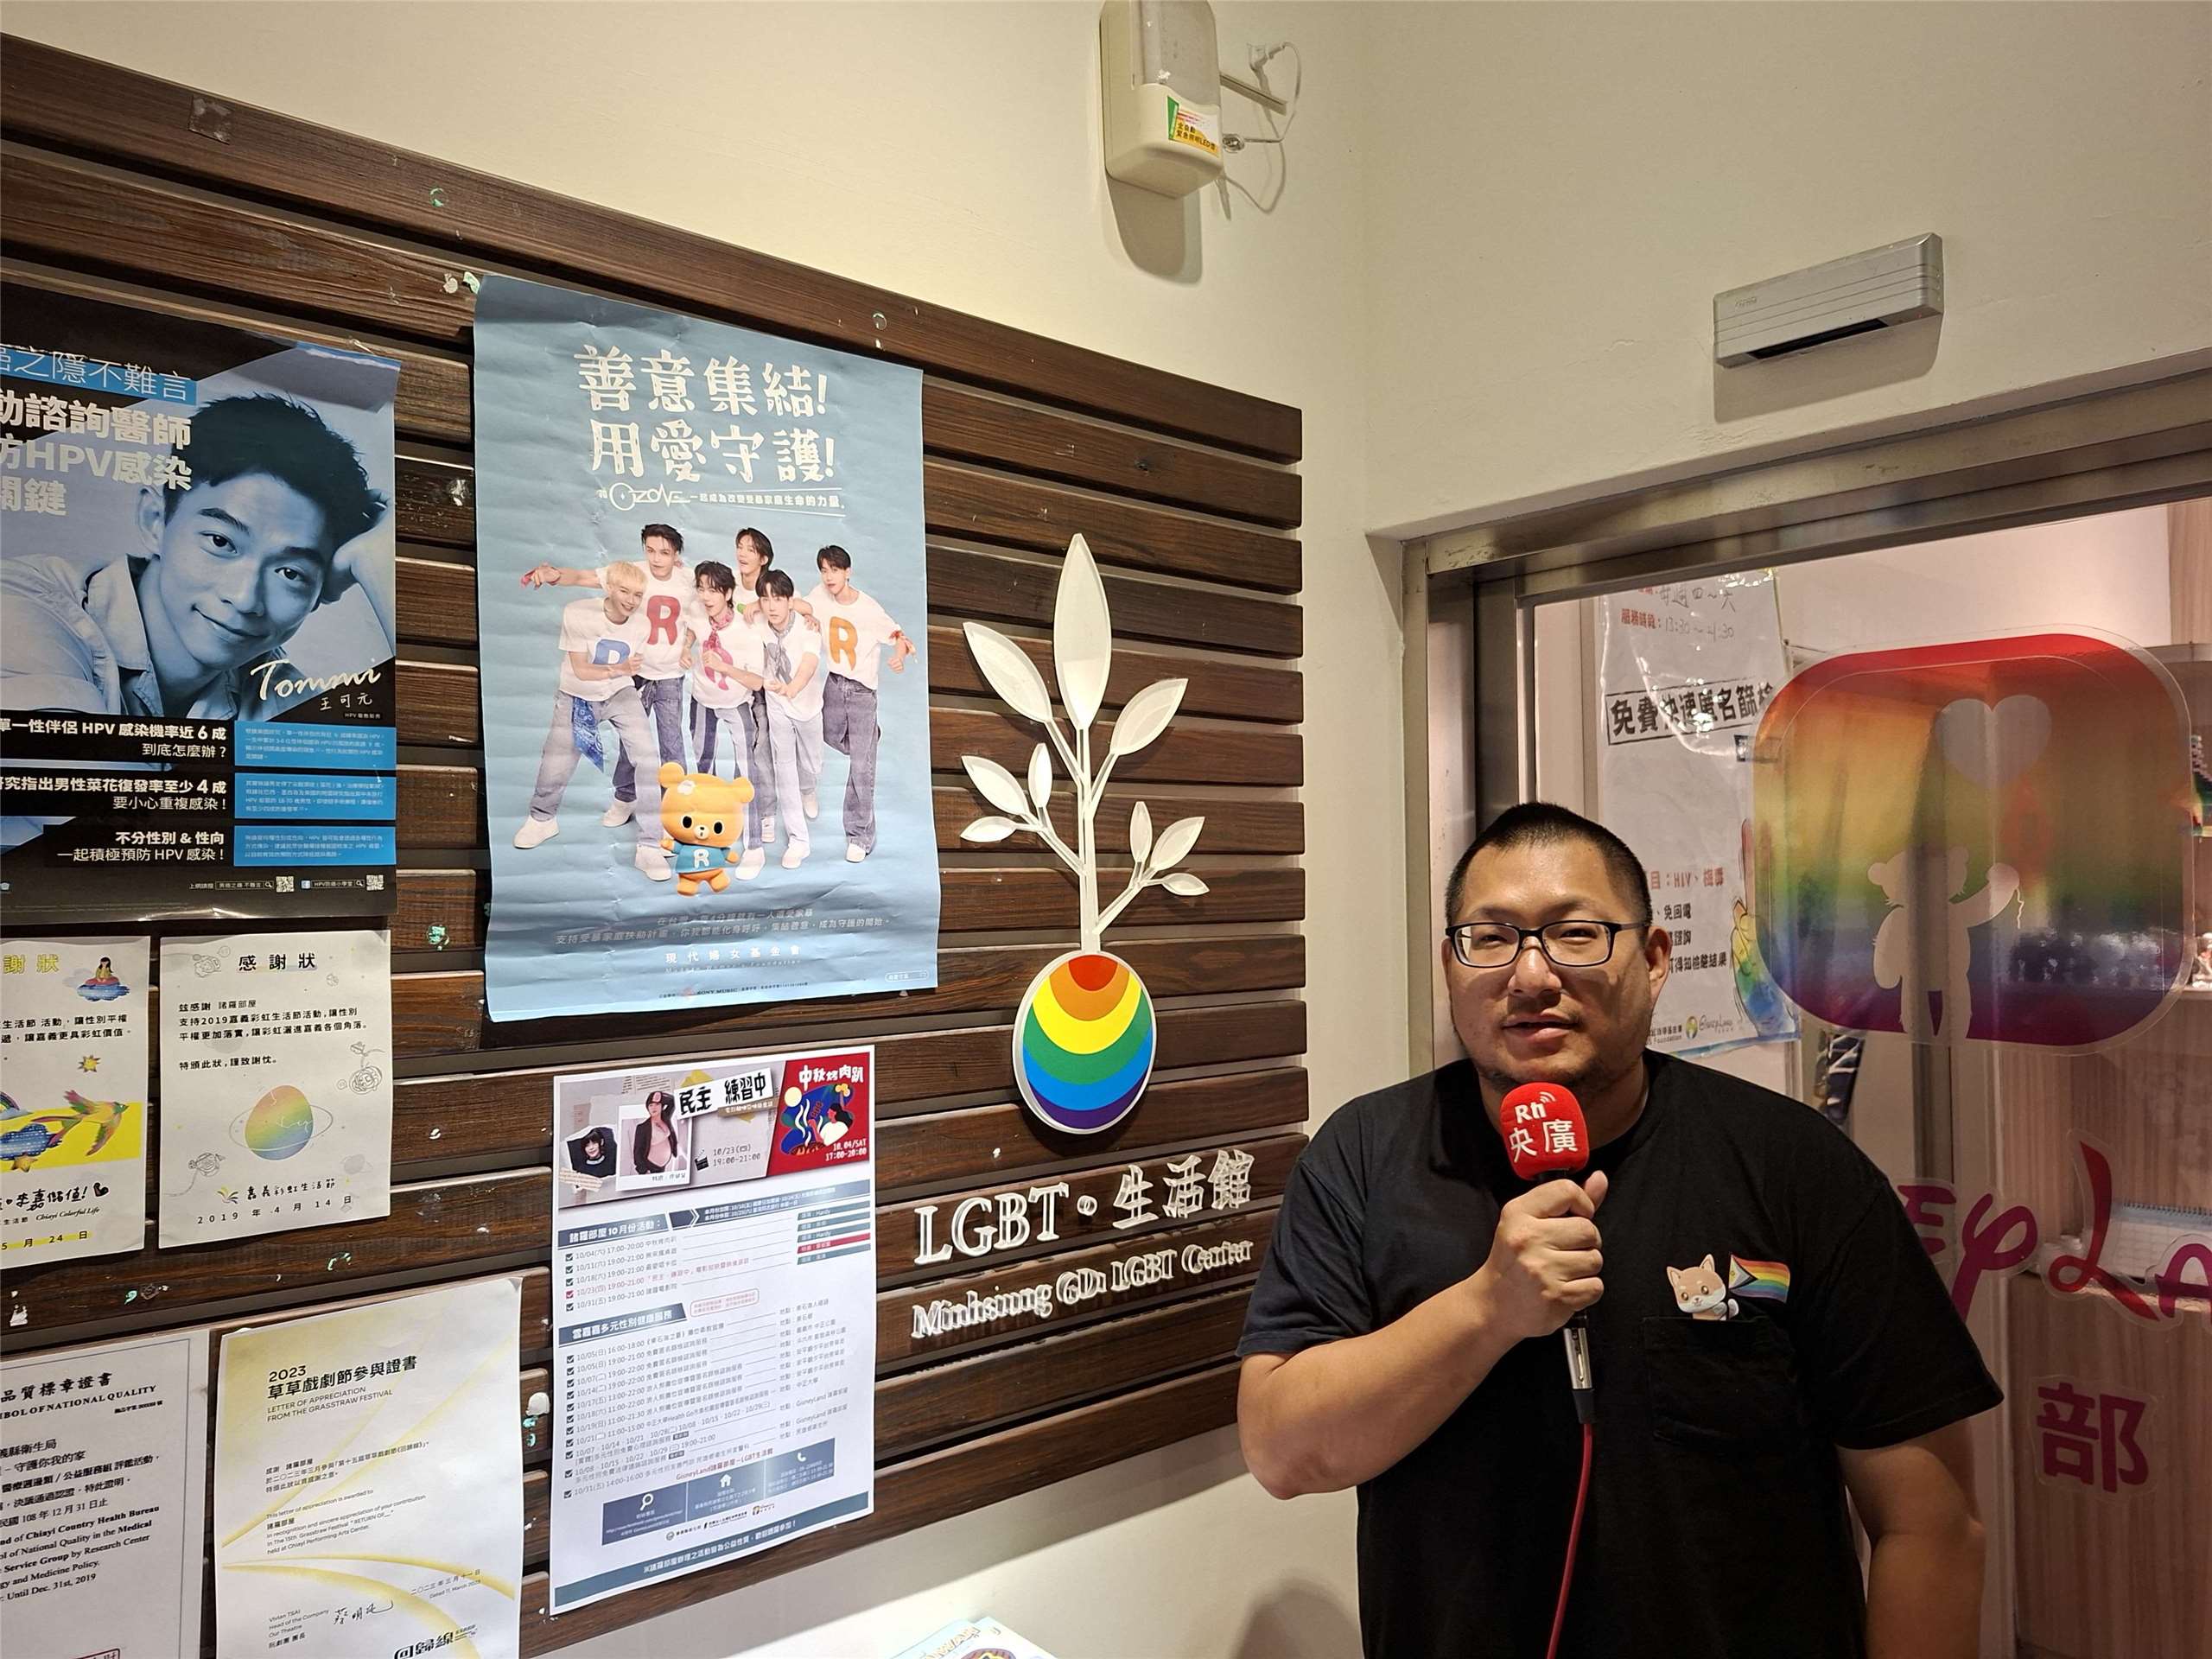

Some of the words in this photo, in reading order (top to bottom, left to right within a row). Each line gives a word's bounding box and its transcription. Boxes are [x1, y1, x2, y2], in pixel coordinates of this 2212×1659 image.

[645, 594, 680, 646] R
[829, 615, 858, 671] R
[250, 657, 382, 702] Tommi
[82, 722, 115, 734] HPV
[198, 726, 208, 740] 6
[212, 727, 226, 741] 成
[0, 776, 193, 794] 究指出男性菜花復發率至少
[197, 779, 208, 794] 4
[212, 780, 227, 795] 成
[116, 831, 176, 845] 不分性別
[180, 834, 192, 844] &
[195, 831, 225, 845] 性向
[155, 849, 183, 861] HPV
[693, 848, 709, 869] R
[238, 952, 316, 971] 感謝狀
[679, 1085, 712, 1116] 民主
[724, 1072, 766, 1104] 練習中
[1509, 1118, 1578, 1163] 央廣
[1112, 1148, 1255, 1230] 生活館
[197, 1211, 238, 1224] 2019
[293, 1203, 302, 1211] 月
[344, 1195, 352, 1204] 日
[914, 1180, 1070, 1266] LGBT
[23, 1238, 34, 1248] 月
[48, 1235, 63, 1243] 24
[79, 1230, 88, 1239] 日
[1110, 1249, 1178, 1293] LGBT
[1180, 1240, 1254, 1274] Center
[267, 1355, 417, 1400] 草草戲劇節參與證書
[268, 1364, 307, 1383] 2023
[0, 1409, 29, 1421] BOL
[47, 1395, 106, 1412] NATIONAL
[107, 1384, 157, 1401] QUALITY
[267, 1402, 296, 1414] LETTER
[296, 1398, 308, 1408] OF
[309, 1386, 366, 1404] APPRECIATION
[267, 1411, 291, 1422] FROM
[292, 1408, 308, 1417] THE
[359, 1389, 394, 1402] FESTIVAL
[2037, 1381, 2150, 1495] 部
[22, 1513, 36, 1523] 108
[39, 1510, 49, 1520] 年
[53, 1508, 62, 1517] 12
[64, 1504, 73, 1515] 月
[58, 1518, 95, 1534] Country
[98, 1513, 127, 1525] Health
[129, 1505, 160, 1518] Bureau
[22, 1541, 57, 1555] National
[60, 1534, 91, 1548] Quality
[92, 1531, 102, 1540] in
[103, 1527, 116, 1538] the
[118, 1520, 153, 1535] Medical
[3, 1560, 38, 1573] Service
[39, 1553, 70, 1566] Group
[71, 1548, 83, 1560] by
[85, 1541, 122, 1556] Research
[123, 1534, 151, 1547] Center
[7, 1588, 29, 1601] Until
[75, 1573, 97, 1586] 2019
[12, 1575, 29, 1586] and
[30, 1566, 71, 1581] Medicine
